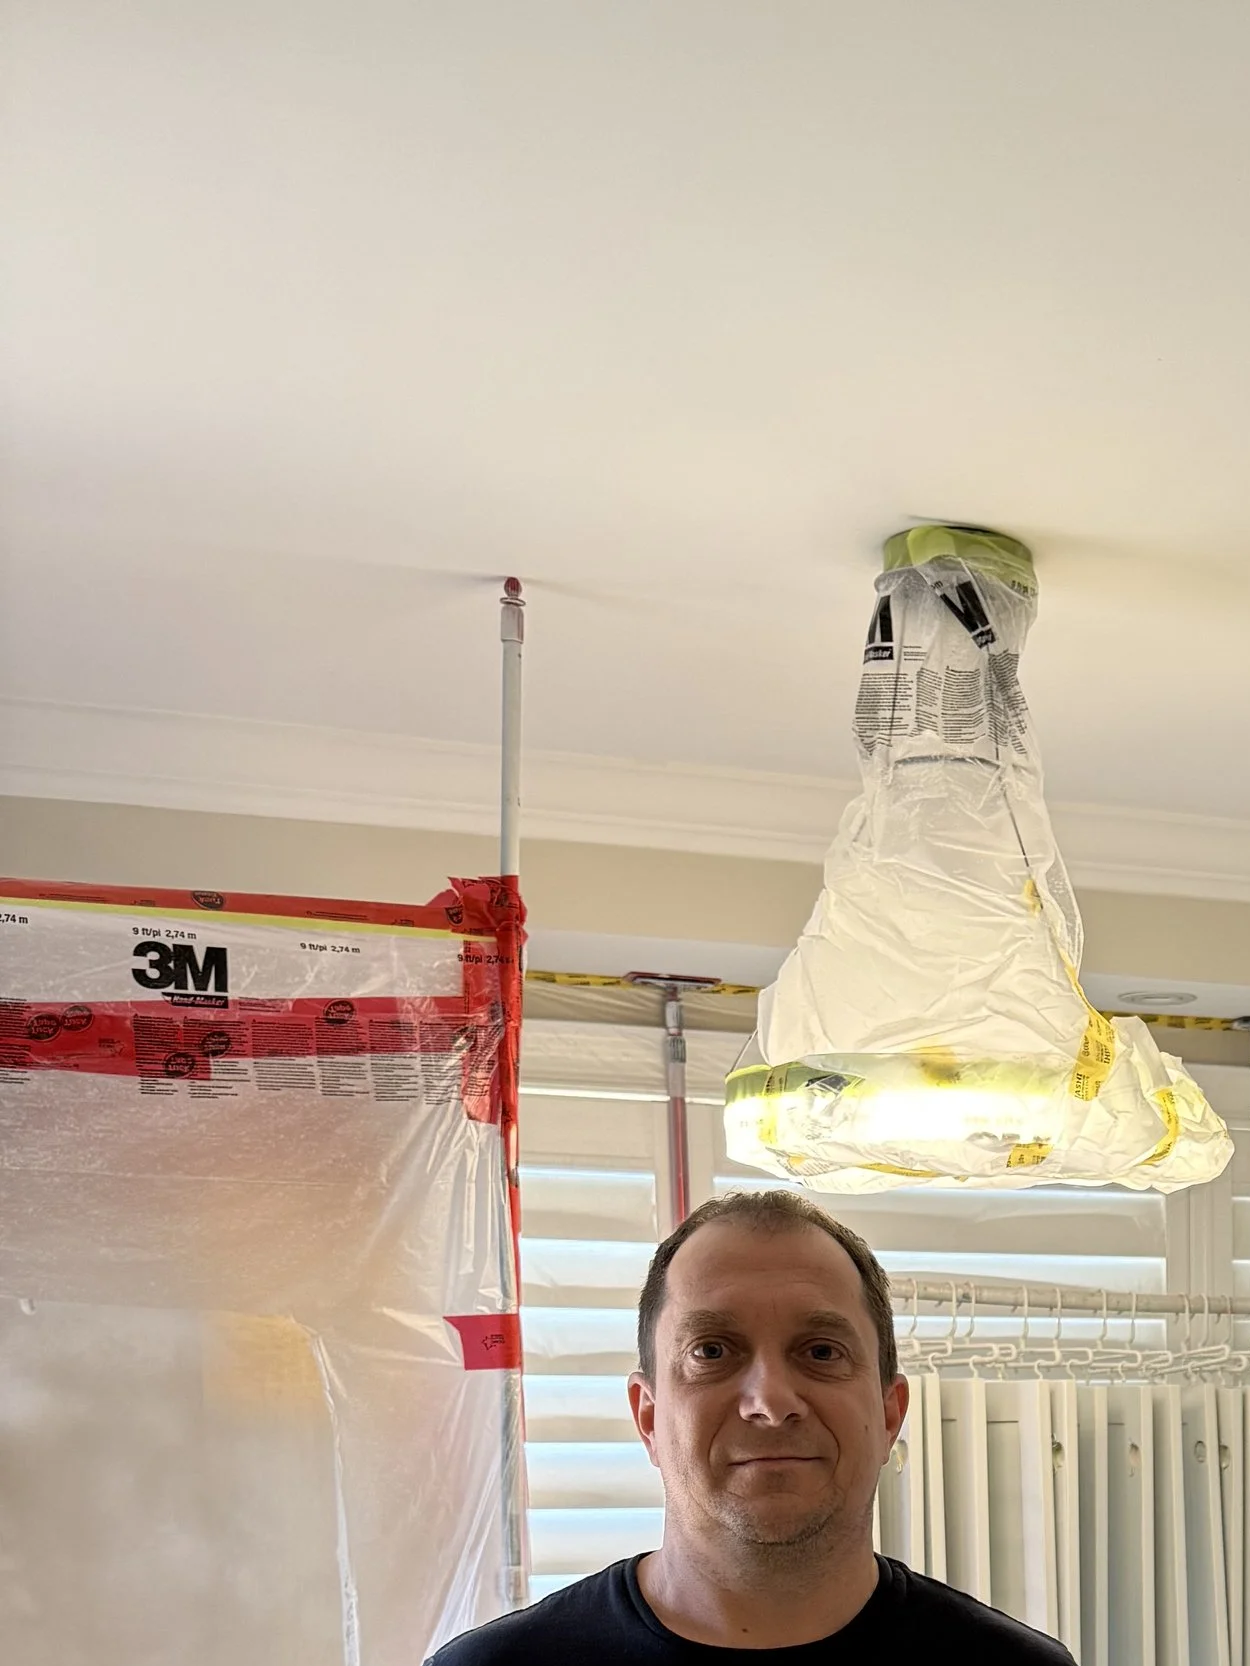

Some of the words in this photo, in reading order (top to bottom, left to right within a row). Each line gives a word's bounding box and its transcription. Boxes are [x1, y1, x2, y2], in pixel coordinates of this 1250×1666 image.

[132, 927, 139, 936] 9
[165, 929, 185, 939] 2,74
[299, 942, 306, 950] 9
[331, 944, 350, 953] 2,74
[131, 940, 229, 992] 3M
